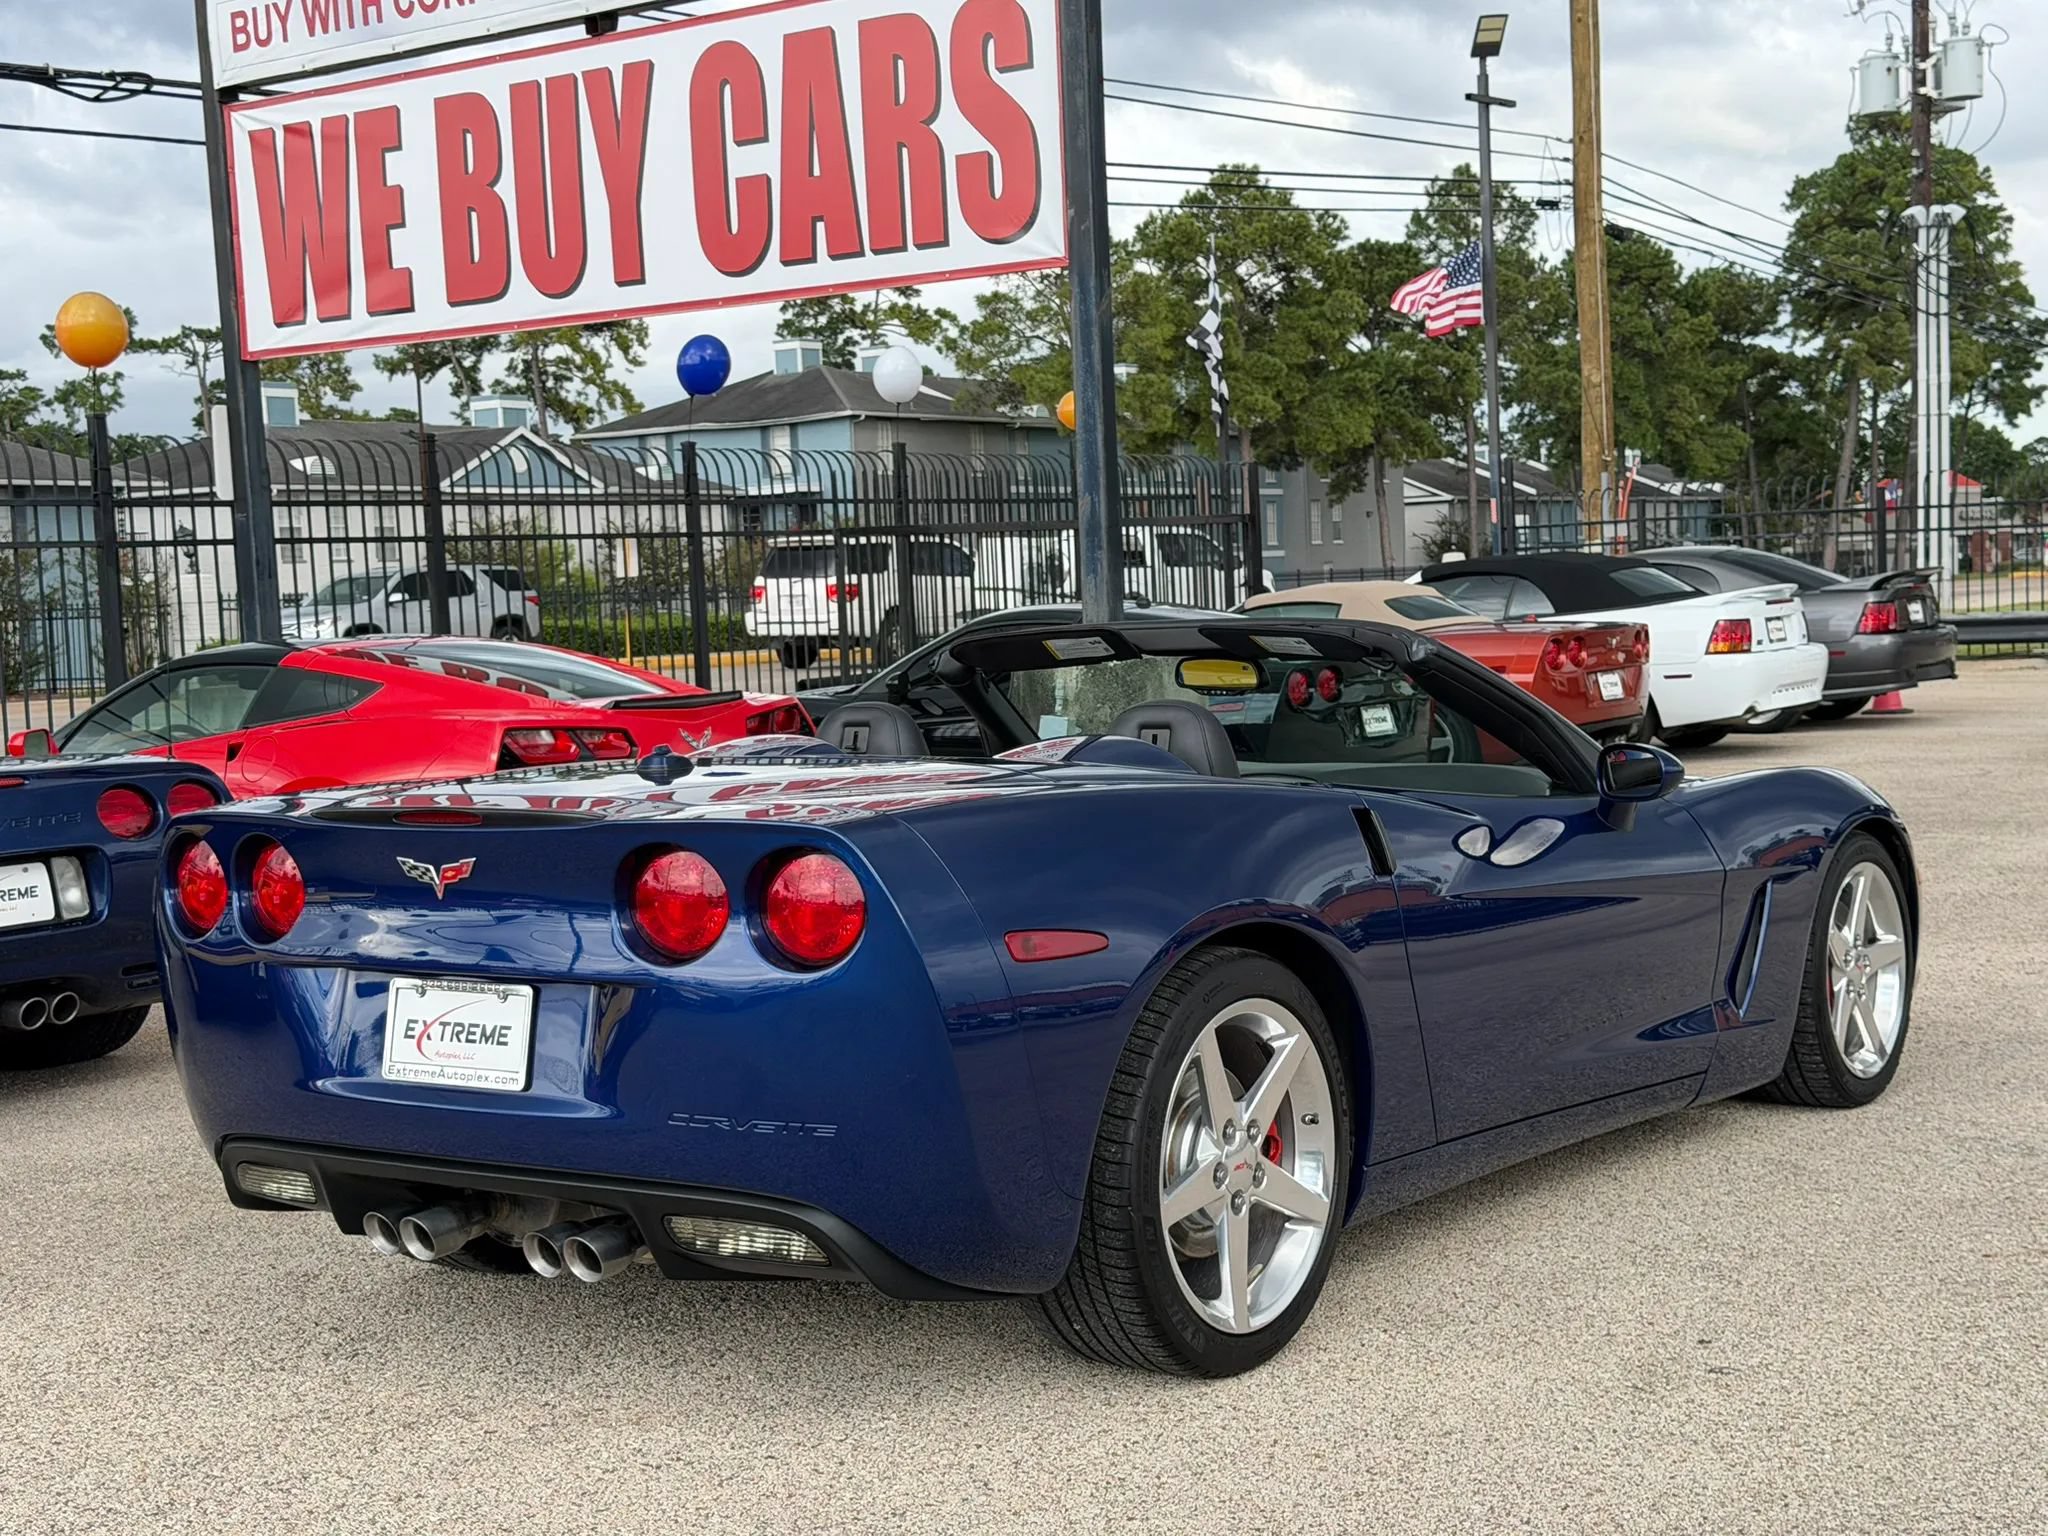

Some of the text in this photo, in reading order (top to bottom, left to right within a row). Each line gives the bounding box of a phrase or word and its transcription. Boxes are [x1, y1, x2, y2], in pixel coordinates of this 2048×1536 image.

[230, 0, 384, 53] BUY WITH
[248, 0, 1042, 328] WE BUY CARS
[403, 1018, 512, 1046] EXTREME
[387, 1064, 519, 1086] ExtremeAutoplex.com
[668, 1112, 838, 1137] CORVETTE
